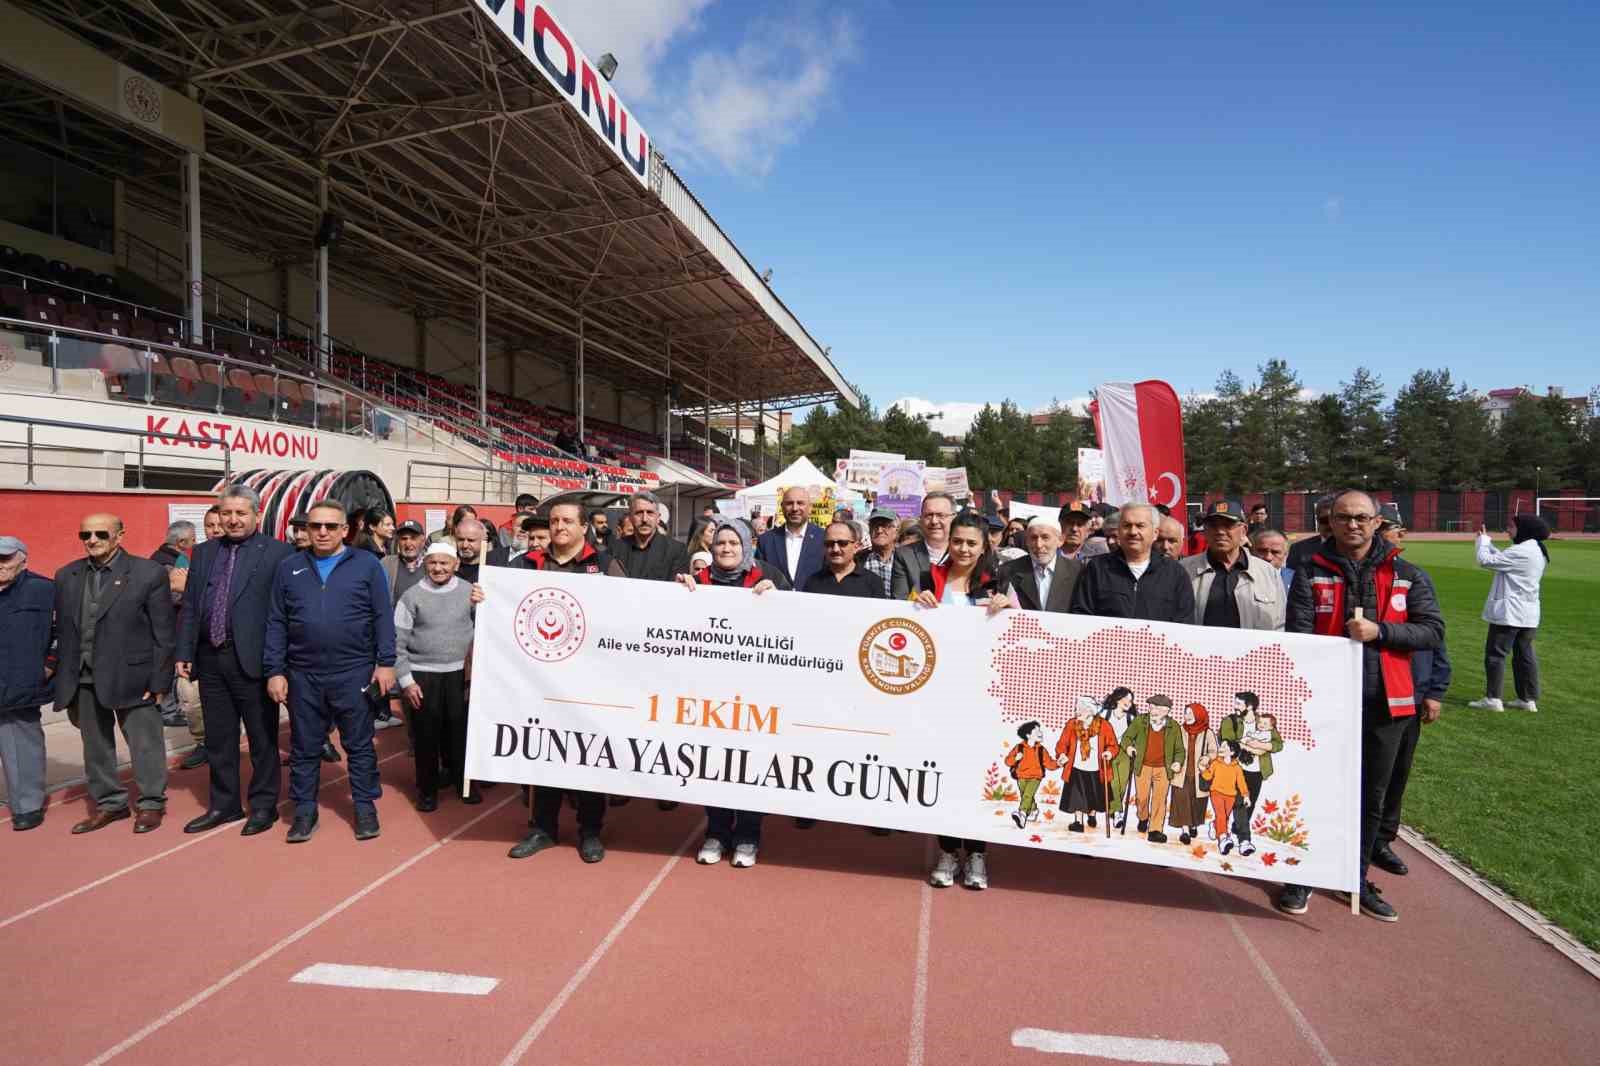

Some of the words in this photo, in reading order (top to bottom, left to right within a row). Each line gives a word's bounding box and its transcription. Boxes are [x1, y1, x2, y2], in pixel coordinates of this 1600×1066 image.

[147, 415, 318, 460] KASTAMONU
[646, 626, 734, 646] KASTAMONU
[736, 635, 794, 651] VALİLİĞİ
[708, 616, 732, 630] T.C.
[597, 637, 623, 651] Aile
[625, 642, 641, 653] ve
[643, 641, 686, 658] Sosyal
[688, 645, 754, 663] Hizmetler
[767, 653, 844, 673] Müdürlüğü
[647, 693, 660, 722] 1
[675, 695, 783, 734] EKİM
[493, 717, 619, 770] DÜNYA
[624, 737, 816, 793] YAŞLILAR
[826, 753, 943, 808] GÜNÜ
